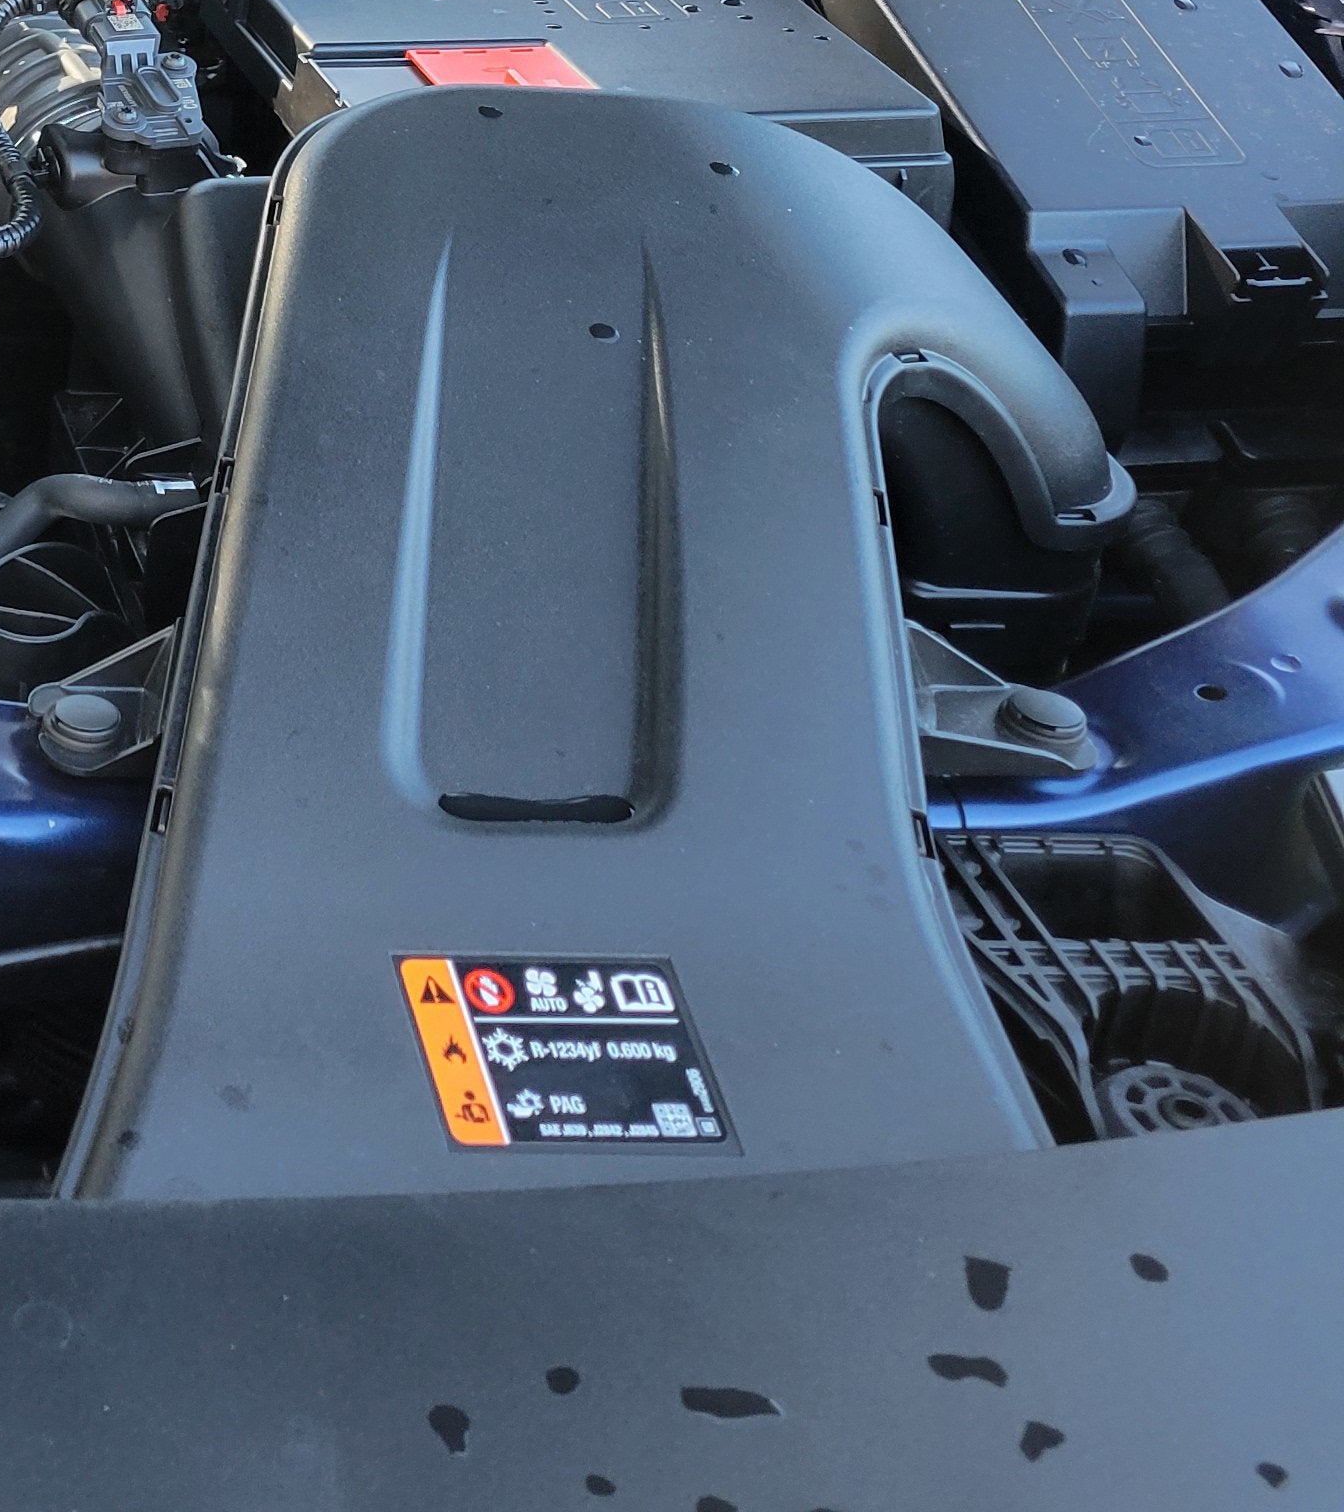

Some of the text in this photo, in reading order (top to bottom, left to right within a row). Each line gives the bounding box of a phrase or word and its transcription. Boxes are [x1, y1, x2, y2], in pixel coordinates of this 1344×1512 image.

[530, 997, 569, 1013] AUTO
[529, 1041, 677, 1062] R-1234yf 0.600 kg
[549, 1095, 587, 1114] PAG
